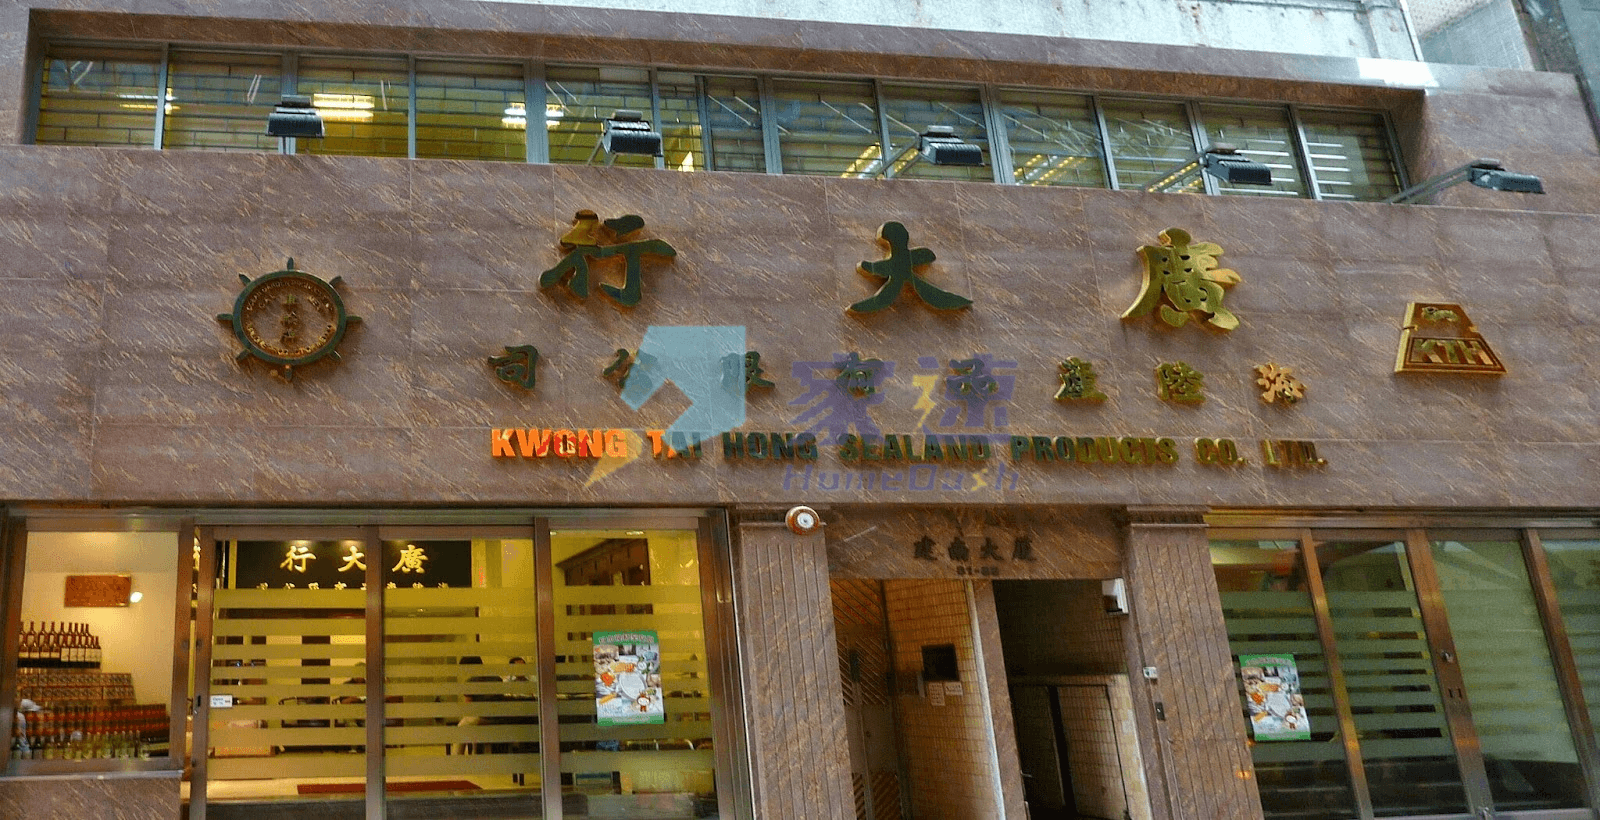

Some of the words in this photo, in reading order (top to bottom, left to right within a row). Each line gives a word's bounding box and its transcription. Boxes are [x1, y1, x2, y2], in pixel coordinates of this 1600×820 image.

[1411, 338, 1494, 365] KTH
[491, 428, 628, 459] KWONG
[646, 429, 703, 460] TAI
[722, 431, 818, 461] HONG
[838, 433, 991, 462] SEALAND
[1010, 435, 1178, 465] PRODUCTS
[1195, 438, 1248, 466] CO.
[1263, 439, 1327, 467] LTD.
